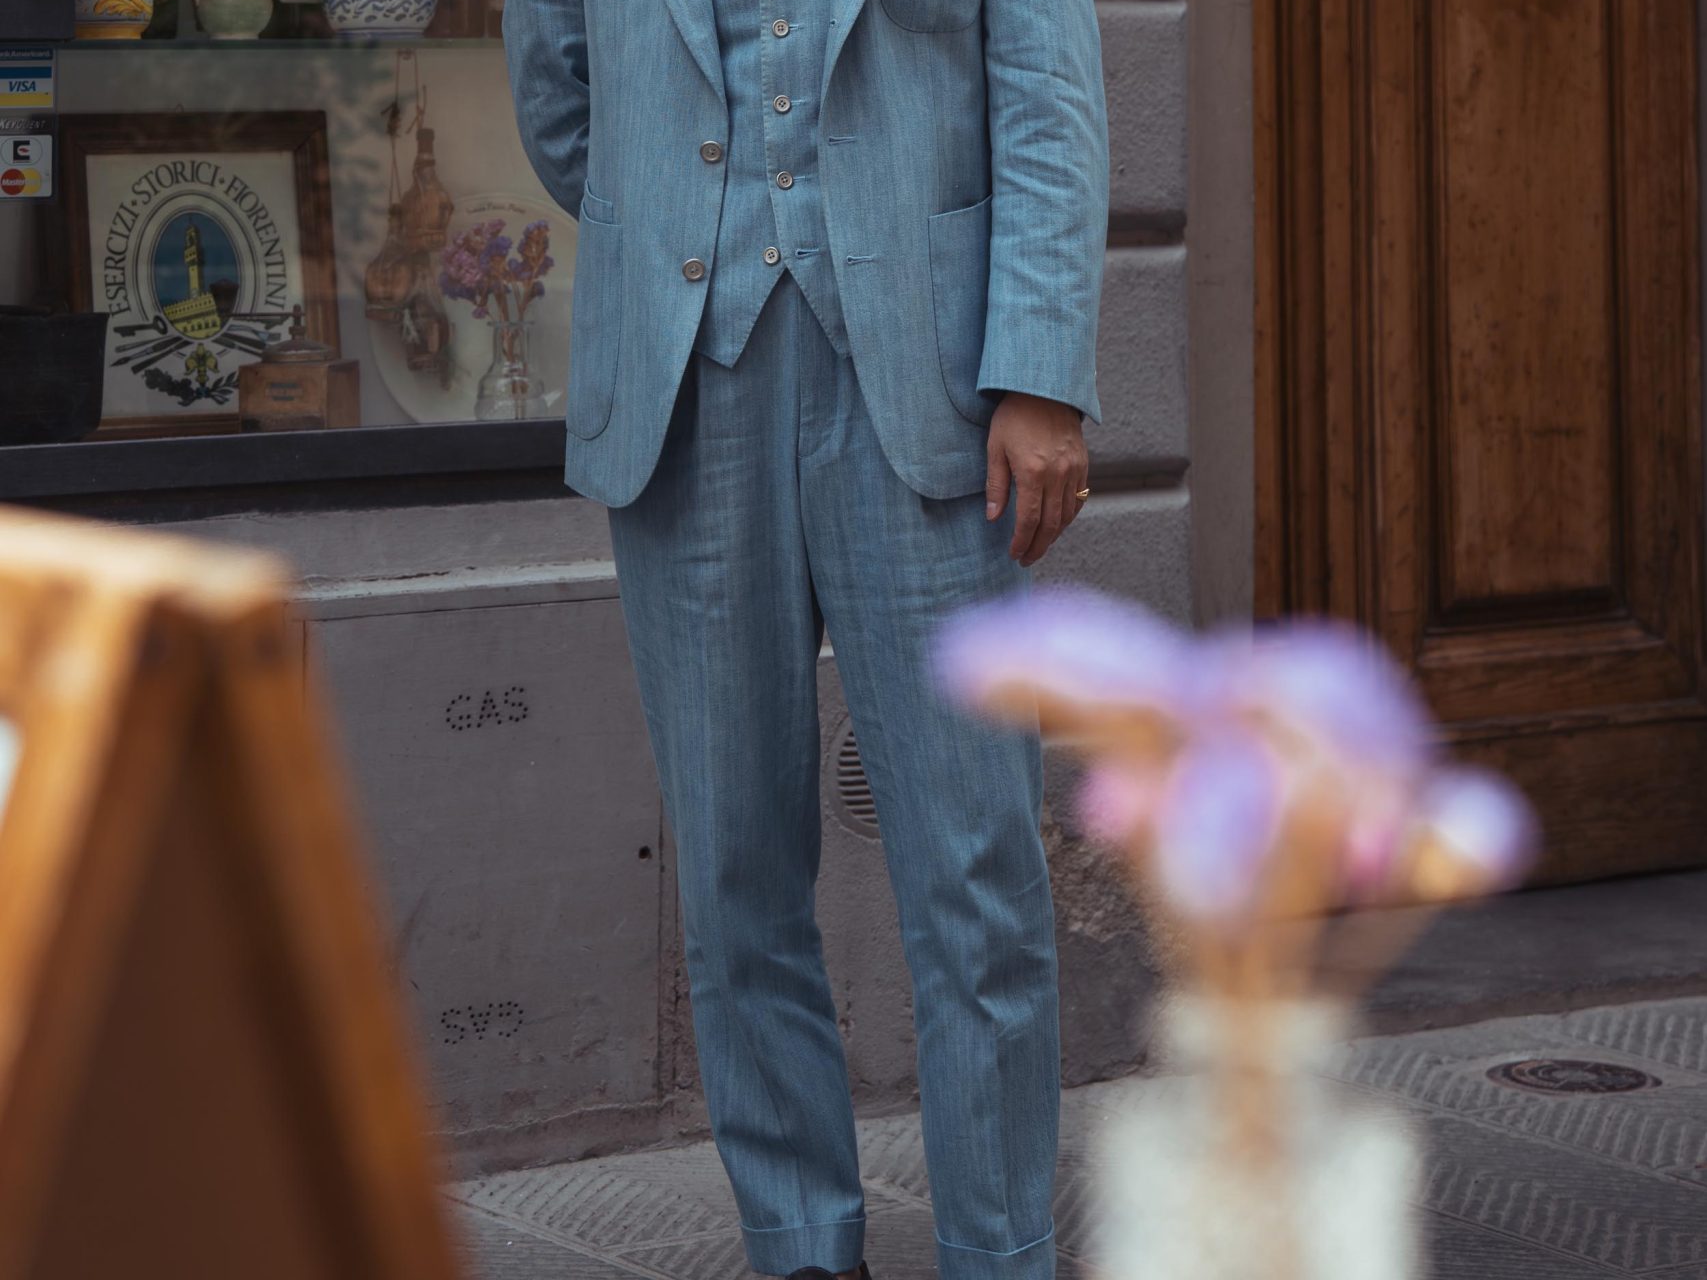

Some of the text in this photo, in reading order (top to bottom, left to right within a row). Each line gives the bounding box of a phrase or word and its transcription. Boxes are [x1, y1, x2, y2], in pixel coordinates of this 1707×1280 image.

[8, 80, 37, 93] VISA
[104, 159, 288, 317] ESERCIZI STORICI FIORENTINI
[445, 685, 529, 732] GAS
[440, 999, 525, 1045] GAS
